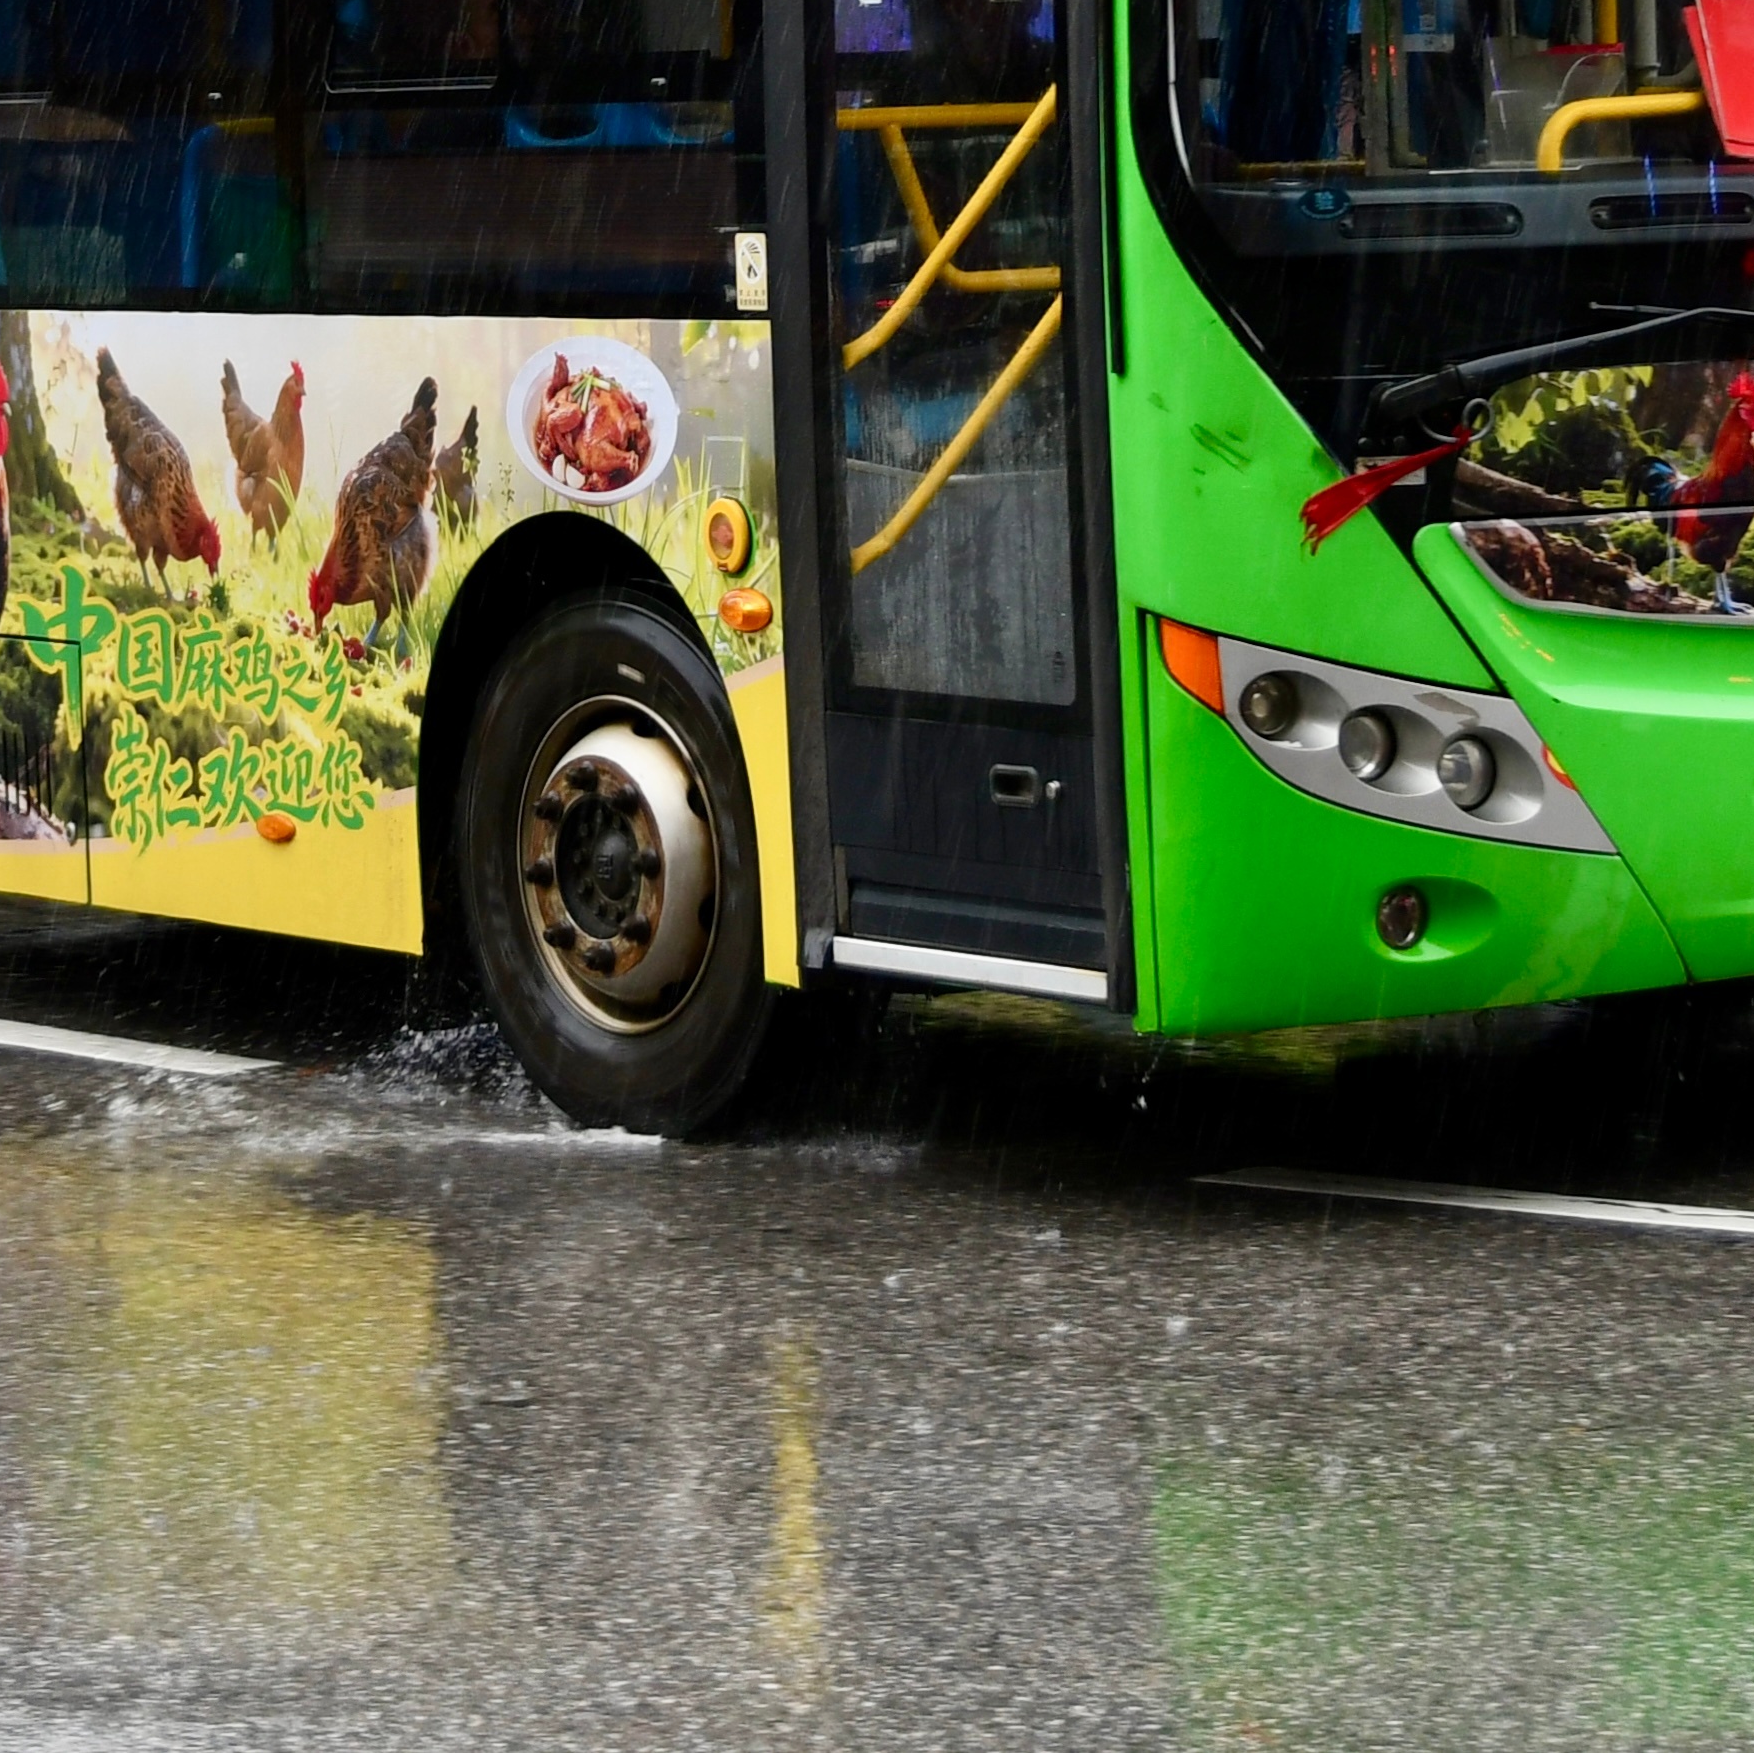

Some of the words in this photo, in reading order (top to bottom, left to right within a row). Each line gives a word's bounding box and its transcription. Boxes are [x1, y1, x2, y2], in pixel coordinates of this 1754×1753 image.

[17, 563, 348, 746] 中国麻鸡之乡
[108, 710, 376, 856] 崇仁欢迎您
